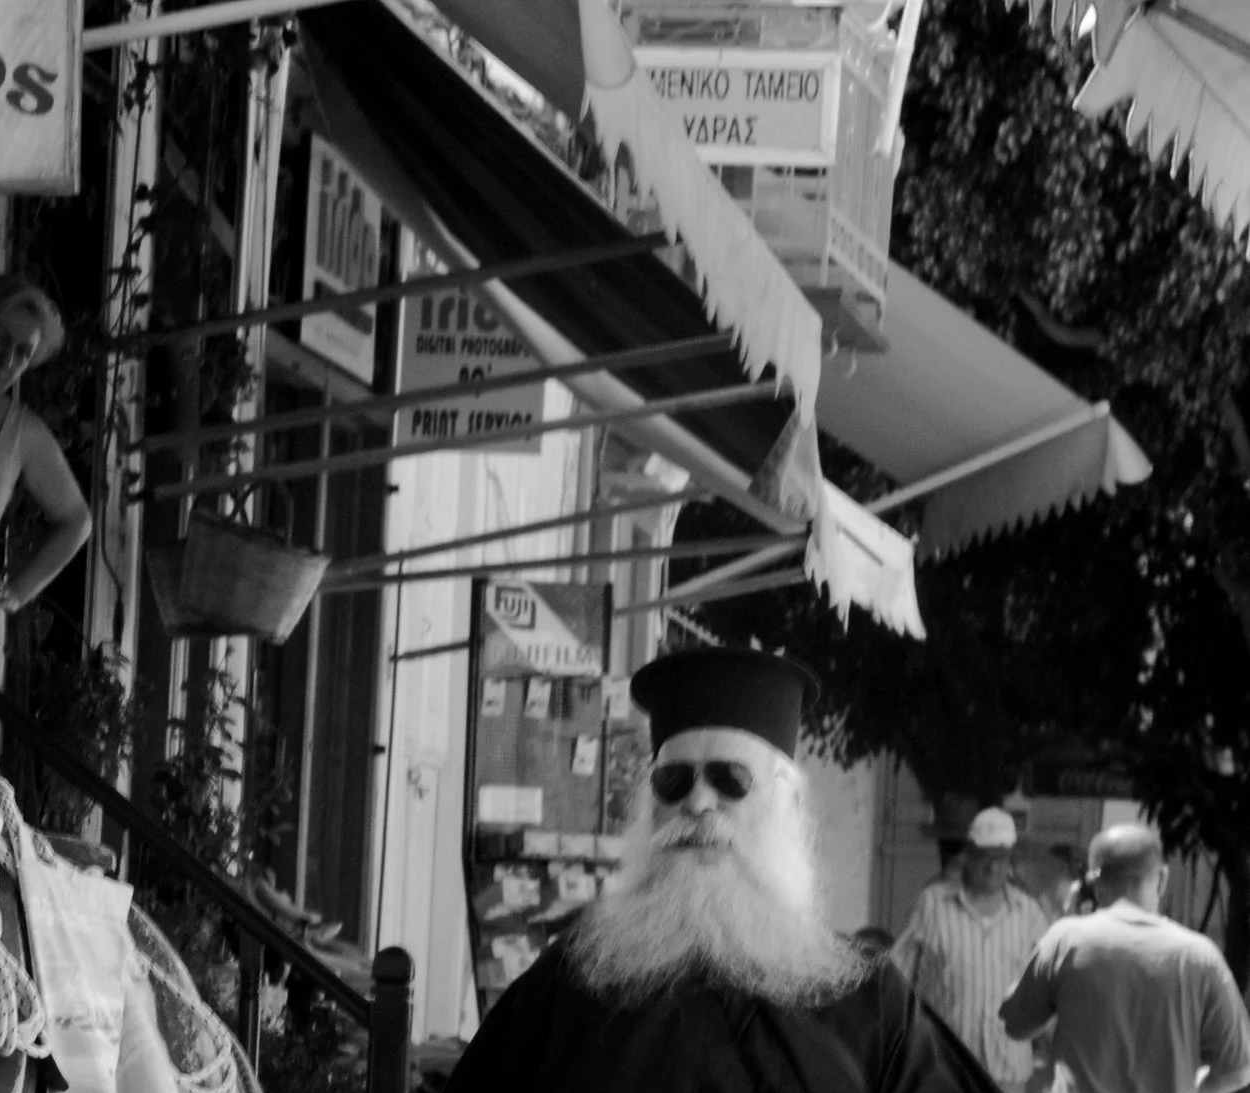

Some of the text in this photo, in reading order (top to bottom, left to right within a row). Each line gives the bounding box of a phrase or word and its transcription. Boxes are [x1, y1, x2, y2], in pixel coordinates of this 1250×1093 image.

[647, 68, 820, 100] ΜΕΝΙΚΟ ΤΑΜΕΙΟ
[683, 114, 759, 145] ΥΔΡΑΣ
[416, 335, 455, 354] DIGITAL
[411, 409, 459, 438] PRINT
